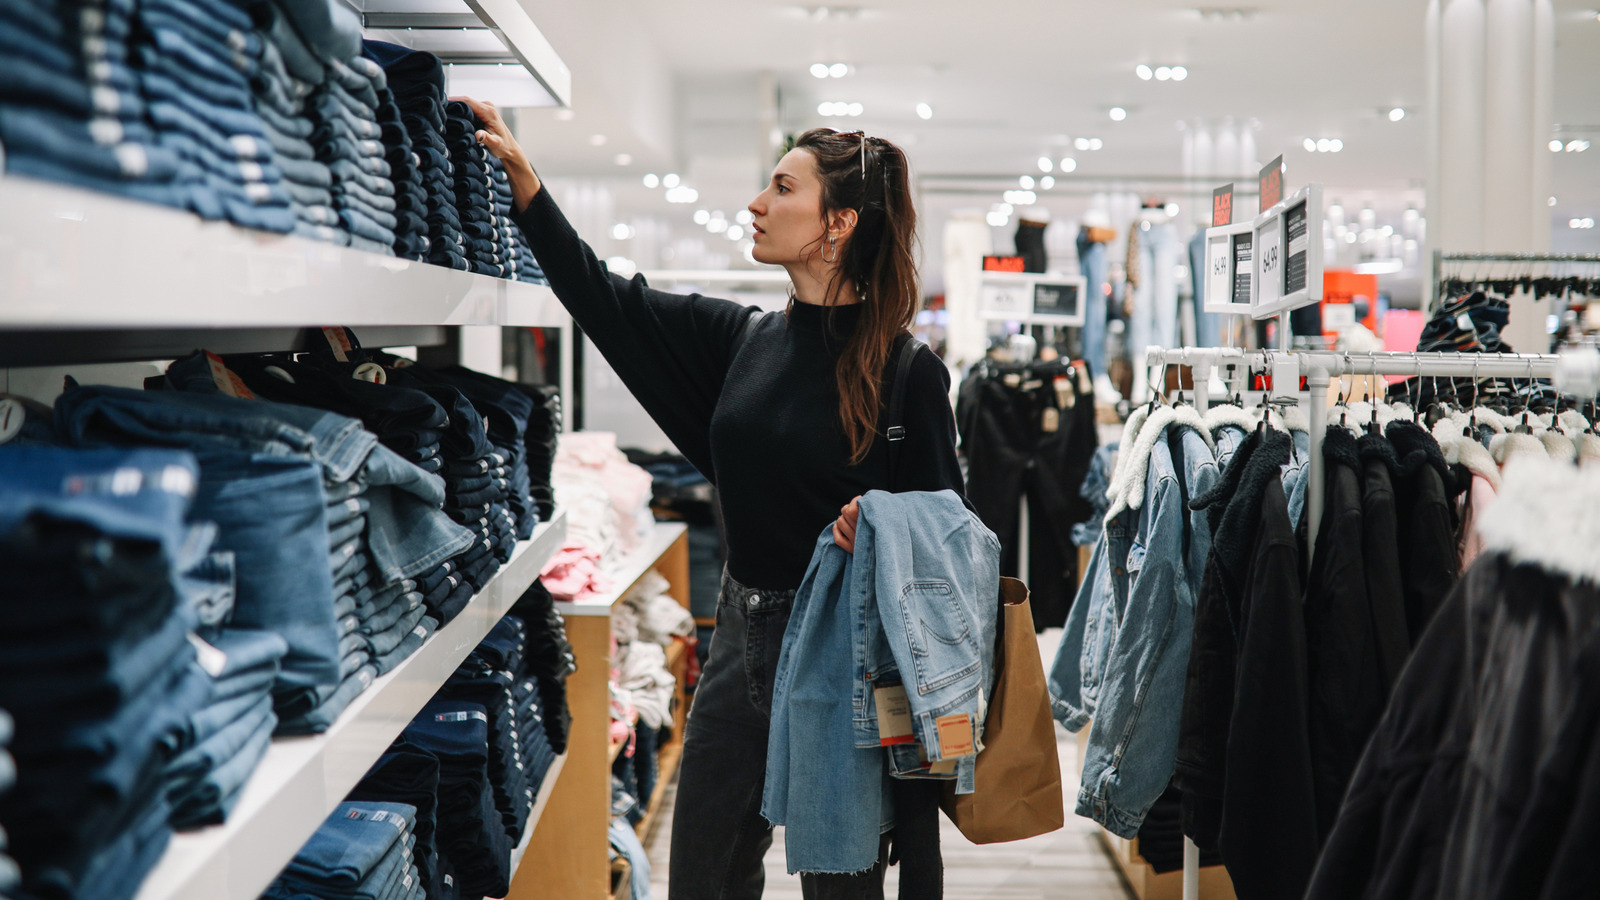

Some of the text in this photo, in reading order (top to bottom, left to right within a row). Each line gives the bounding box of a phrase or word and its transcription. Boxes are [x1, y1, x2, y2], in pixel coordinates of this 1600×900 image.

[1214, 192, 1231, 211] BLACK
[1214, 256, 1227, 275] 64.99
[1263, 245, 1278, 273] 64.99
